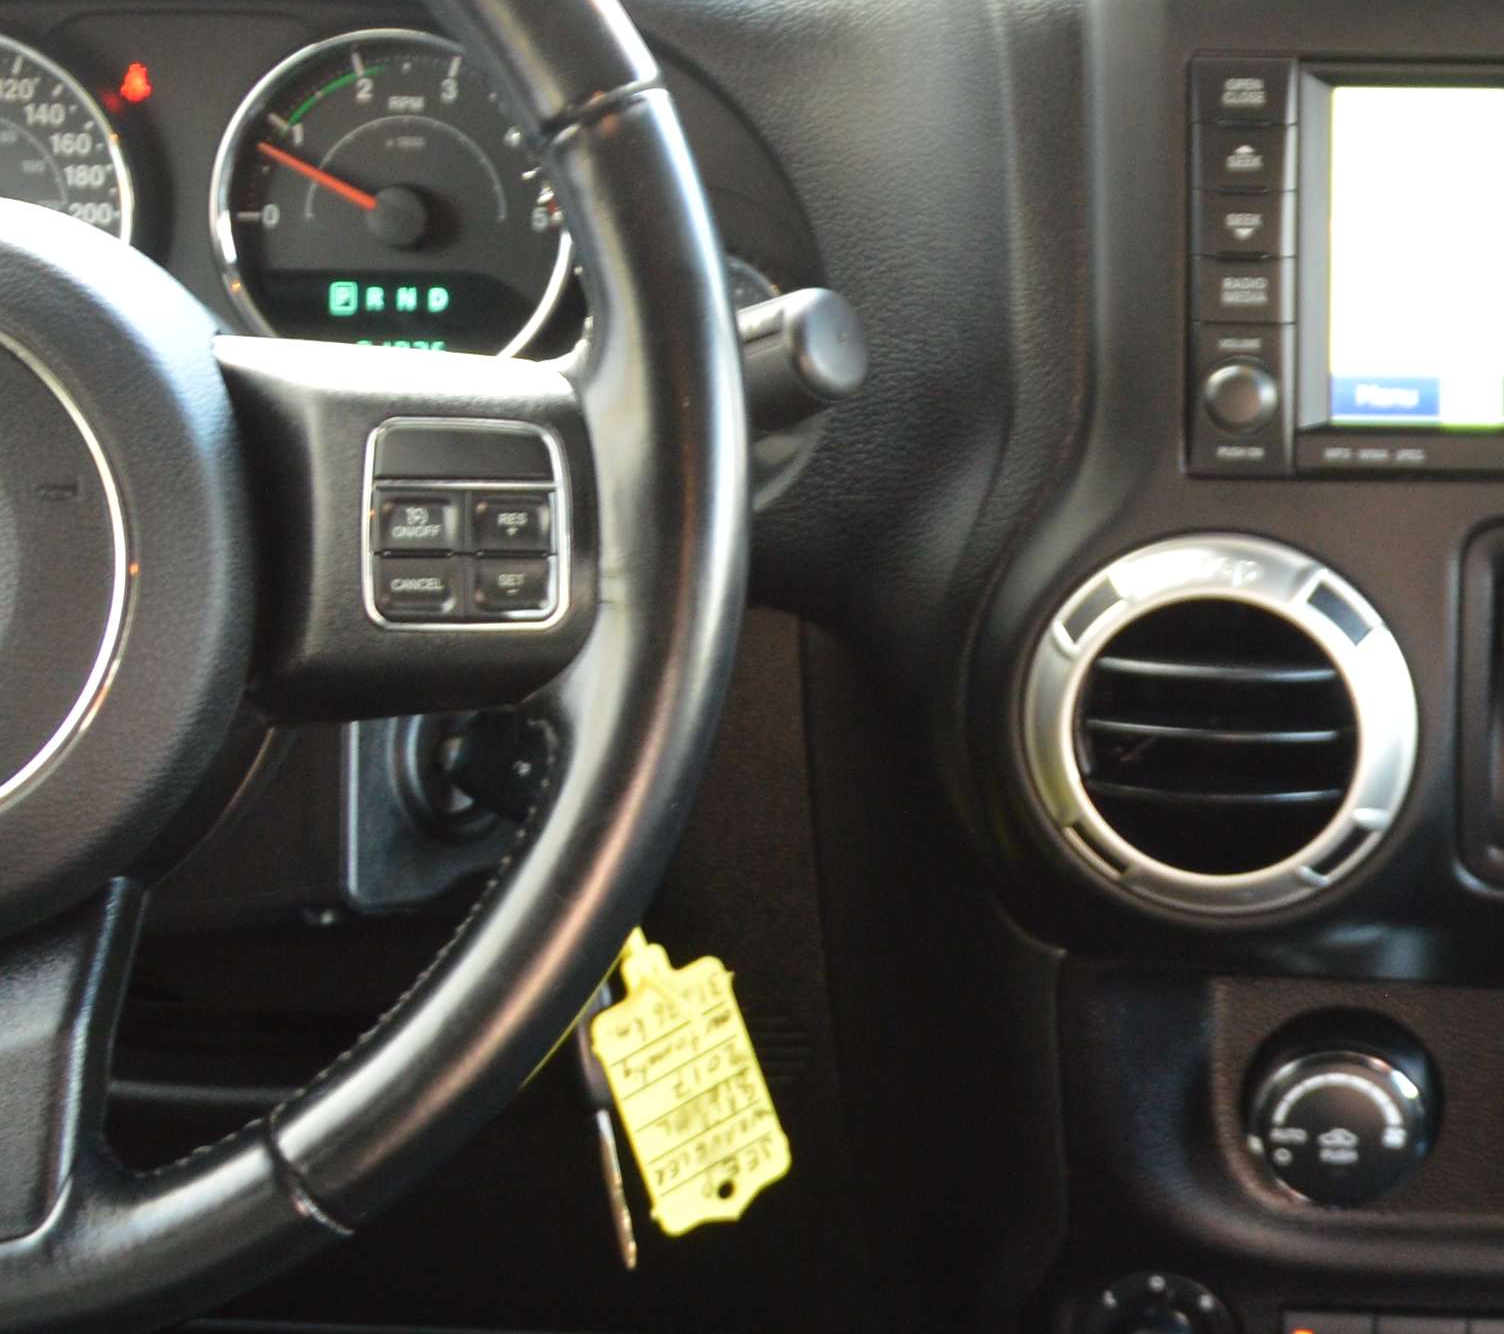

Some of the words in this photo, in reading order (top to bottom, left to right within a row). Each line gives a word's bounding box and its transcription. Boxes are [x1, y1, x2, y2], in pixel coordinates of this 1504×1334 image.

[357, 79, 372, 100] 2
[442, 80, 457, 100] 3
[1221, 91, 1266, 104] CLOSE
[26, 104, 65, 124] 140
[51, 133, 91, 154] 160
[1227, 155, 1263, 167] SEEK
[66, 165, 103, 185] 180
[69, 203, 112, 225] 200
[262, 205, 279, 228] 0
[1225, 213, 1262, 226] SEEK
[1222, 277, 1267, 289] RADIO
[366, 287, 384, 311] R
[397, 287, 417, 311] N
[428, 287, 449, 313] D
[1221, 290, 1266, 303] MEDIA
[498, 513, 527, 525] RES
[392, 526, 441, 538] ON/OFF
[391, 578, 444, 590] CANCEL
[498, 575, 525, 587] SET
[677, 1040, 748, 1099] 2017
[702, 1136, 772, 1195] JEEP
